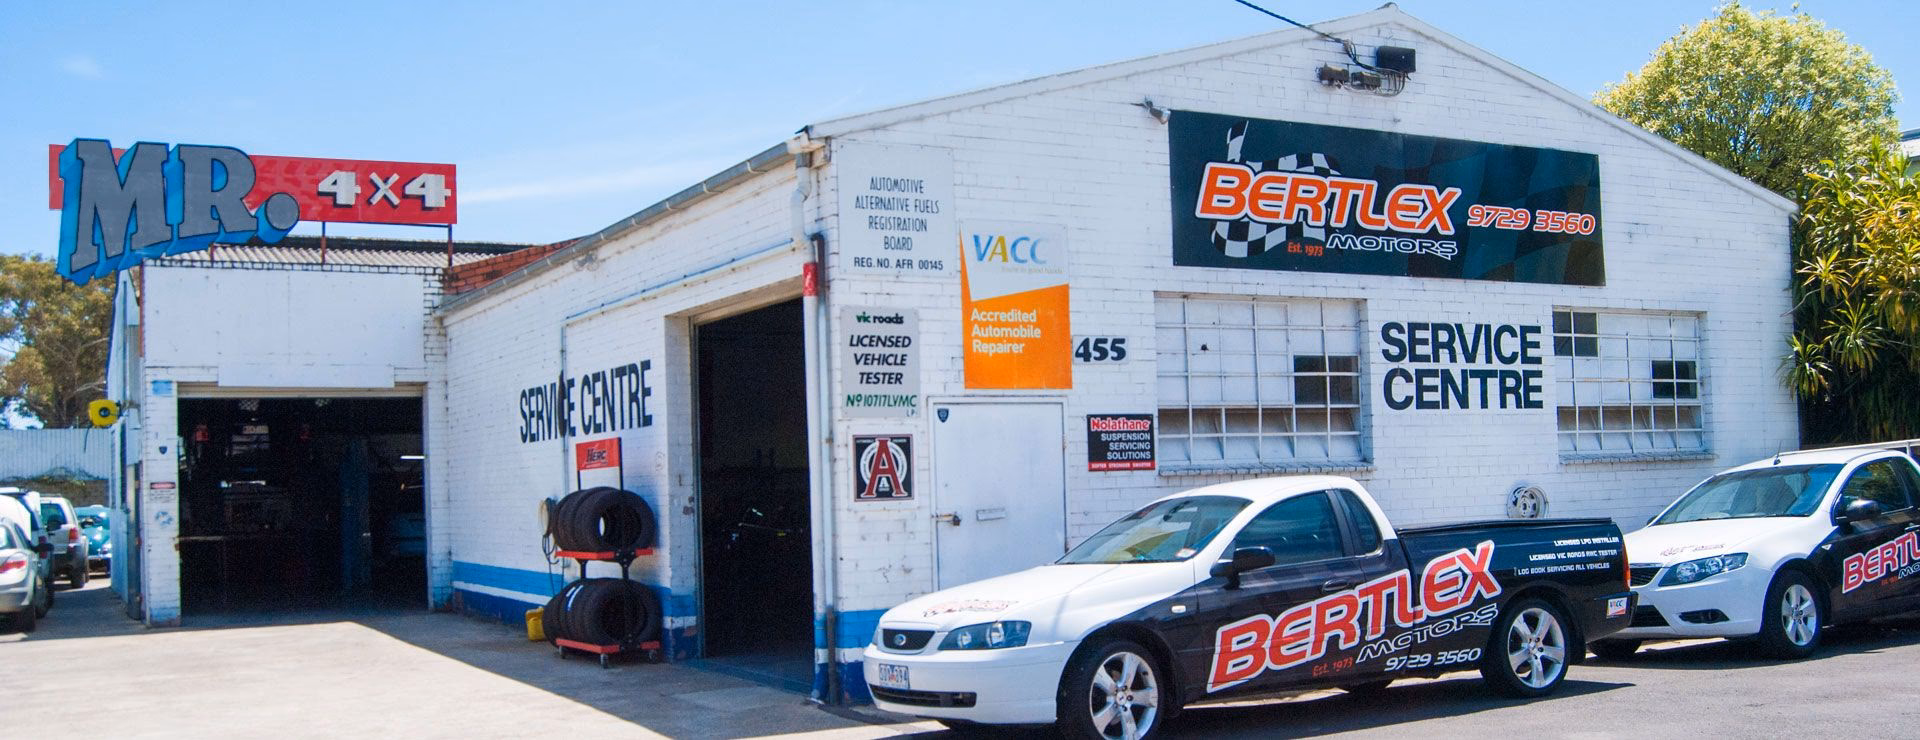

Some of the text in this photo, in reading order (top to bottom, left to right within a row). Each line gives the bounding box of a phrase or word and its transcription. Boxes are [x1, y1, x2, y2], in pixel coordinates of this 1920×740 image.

[869, 176, 924, 194] AUTOMOTIVE
[855, 195, 939, 214] ALTERNATIVE FUELS
[1195, 161, 1462, 235] BERTLEX
[57, 138, 299, 285] MR.
[1467, 204, 1596, 236] 9729 3560
[868, 215, 928, 232] REGISTRATION
[883, 235, 913, 251] BOARD
[973, 234, 1049, 264] VACC
[1287, 242, 1324, 257] Est. 1973
[1326, 234, 1457, 260] MOTORS
[895, 259, 914, 269] AFR
[918, 259, 944, 270] 00145
[873, 313, 904, 324] roads
[970, 308, 1037, 322] Accredited
[971, 324, 1042, 338] Automobile
[849, 334, 912, 348] LICENSED
[972, 339, 1025, 358] Repairer
[1074, 336, 1127, 363] 455
[1381, 321, 1543, 365] SERVICE
[854, 353, 908, 366] VEHICLE
[859, 372, 904, 385] TESTER
[1383, 367, 1544, 411] CENTRE
[519, 359, 653, 444] SERVICE CENTRE
[1090, 417, 1151, 432] Nolathane
[1101, 432, 1151, 441] SUSPENSION
[1109, 441, 1151, 450] SERVICING
[1106, 451, 1151, 460] SOLUTIONS
[1598, 549, 1618, 557] TESTER
[1517, 567, 1530, 575] LOG
[1530, 566, 1546, 575] BOOK
[1547, 564, 1575, 573] SERVICING
[1586, 562, 1610, 570] VEHICLES
[1206, 538, 1503, 694] BERTLEX
[1355, 602, 1499, 664] MOTORS
[1384, 647, 1482, 672] 9729 3560
